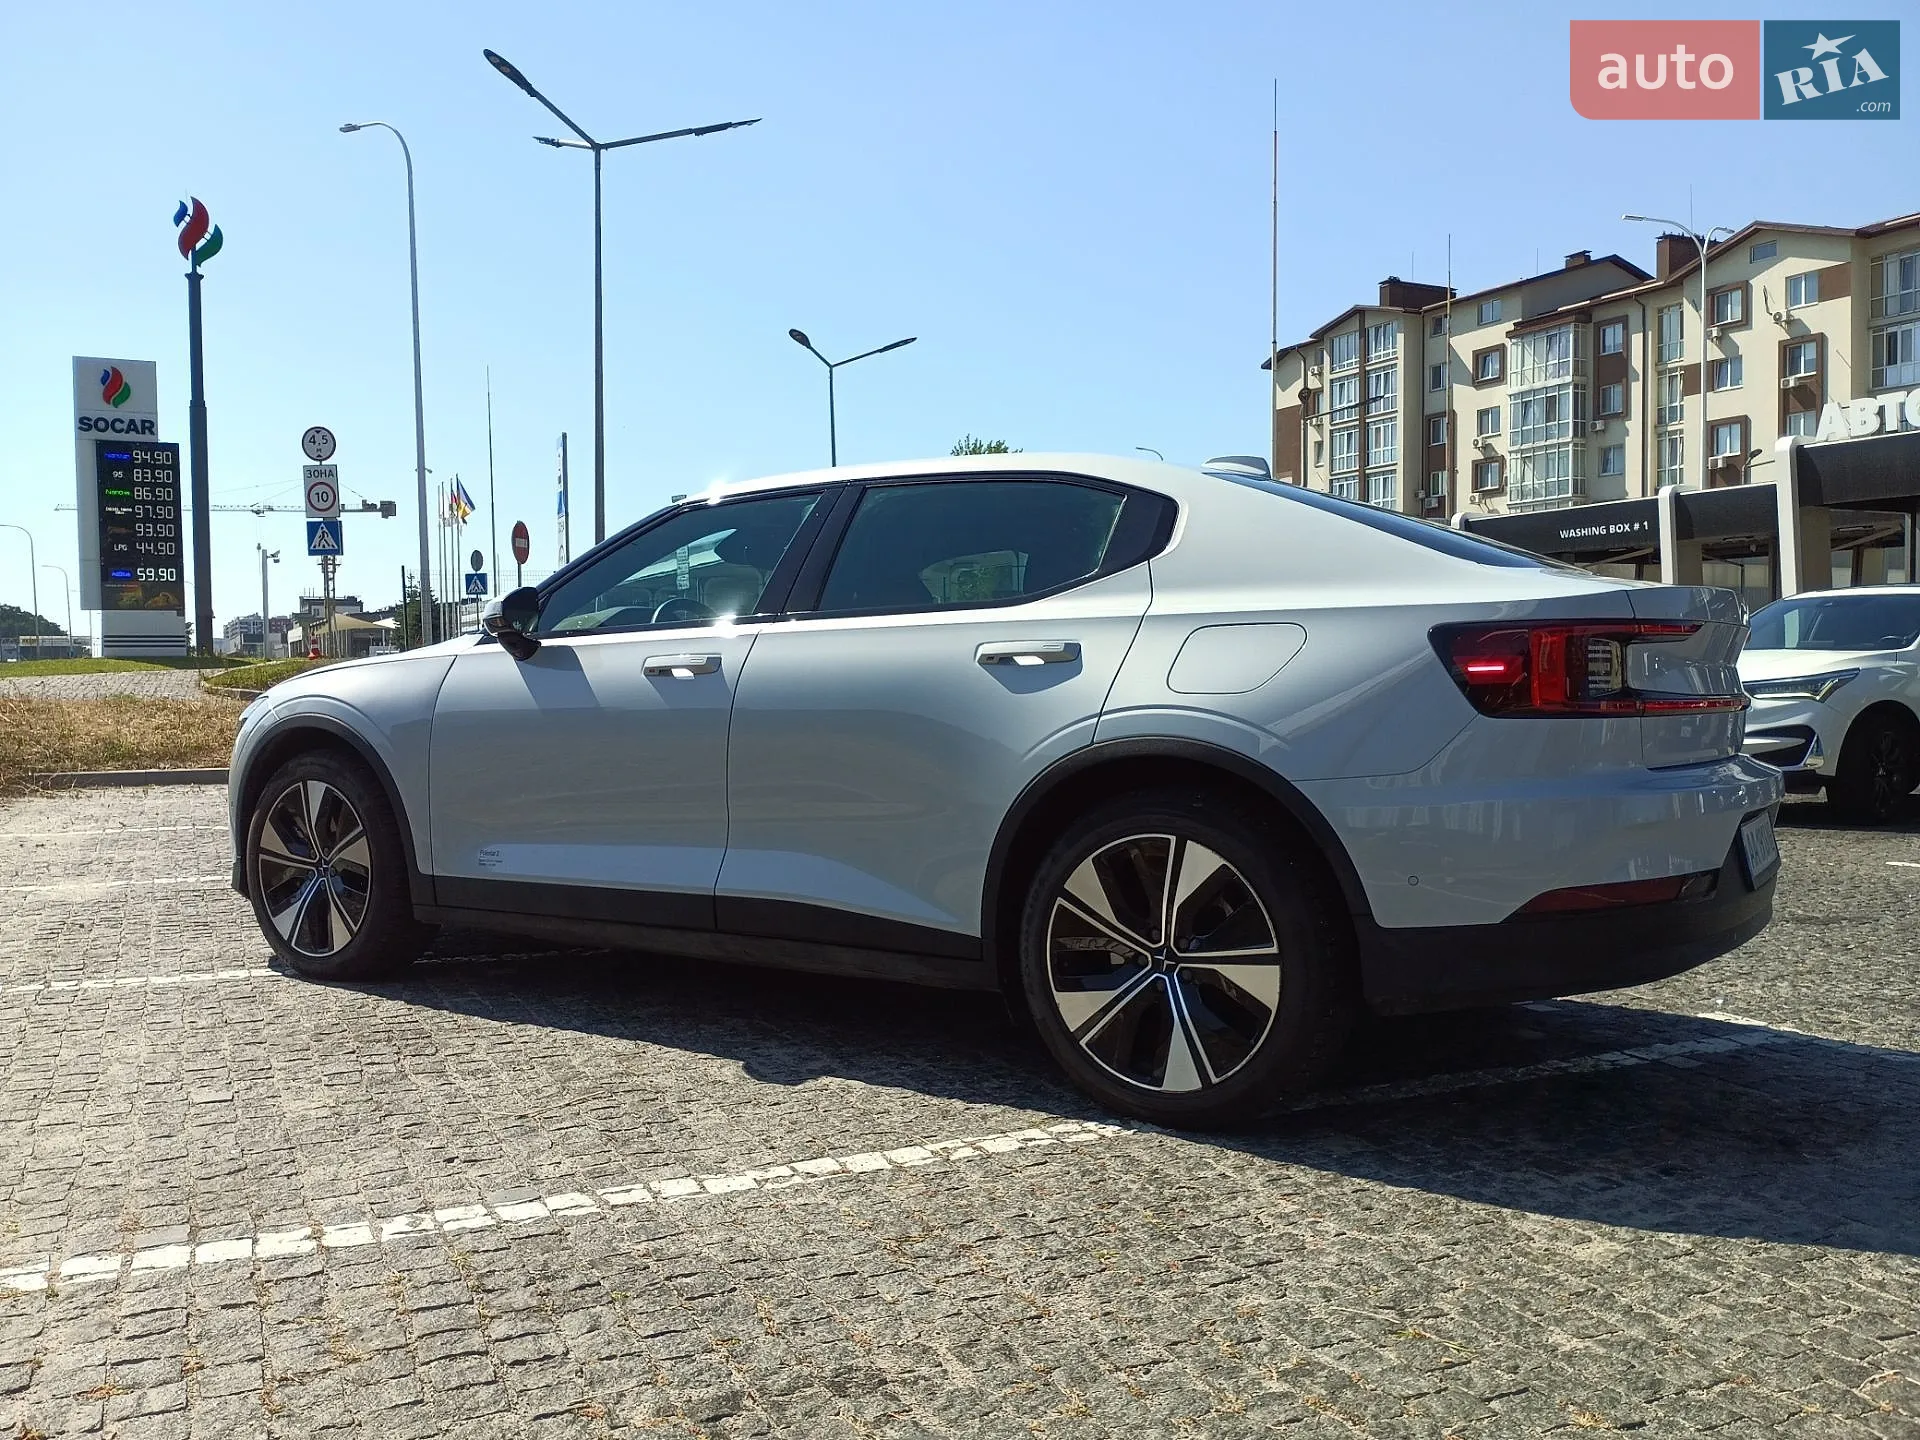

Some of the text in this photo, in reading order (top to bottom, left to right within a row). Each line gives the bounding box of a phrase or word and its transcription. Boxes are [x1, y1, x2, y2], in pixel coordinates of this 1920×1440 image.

[78, 416, 155, 435] SOCAR
[133, 450, 172, 464] 94.90
[112, 469, 173, 483] 95 83.90
[306, 469, 335, 479] ЗОНА
[134, 487, 173, 501] 86.90
[315, 491, 329, 503] 10
[135, 505, 174, 519] 97.90
[135, 523, 175, 537] 93.90
[1560, 520, 1649, 539] WASHING BOX # 1
[113, 542, 175, 555] LPG 44.90
[137, 568, 176, 581] 59.90
